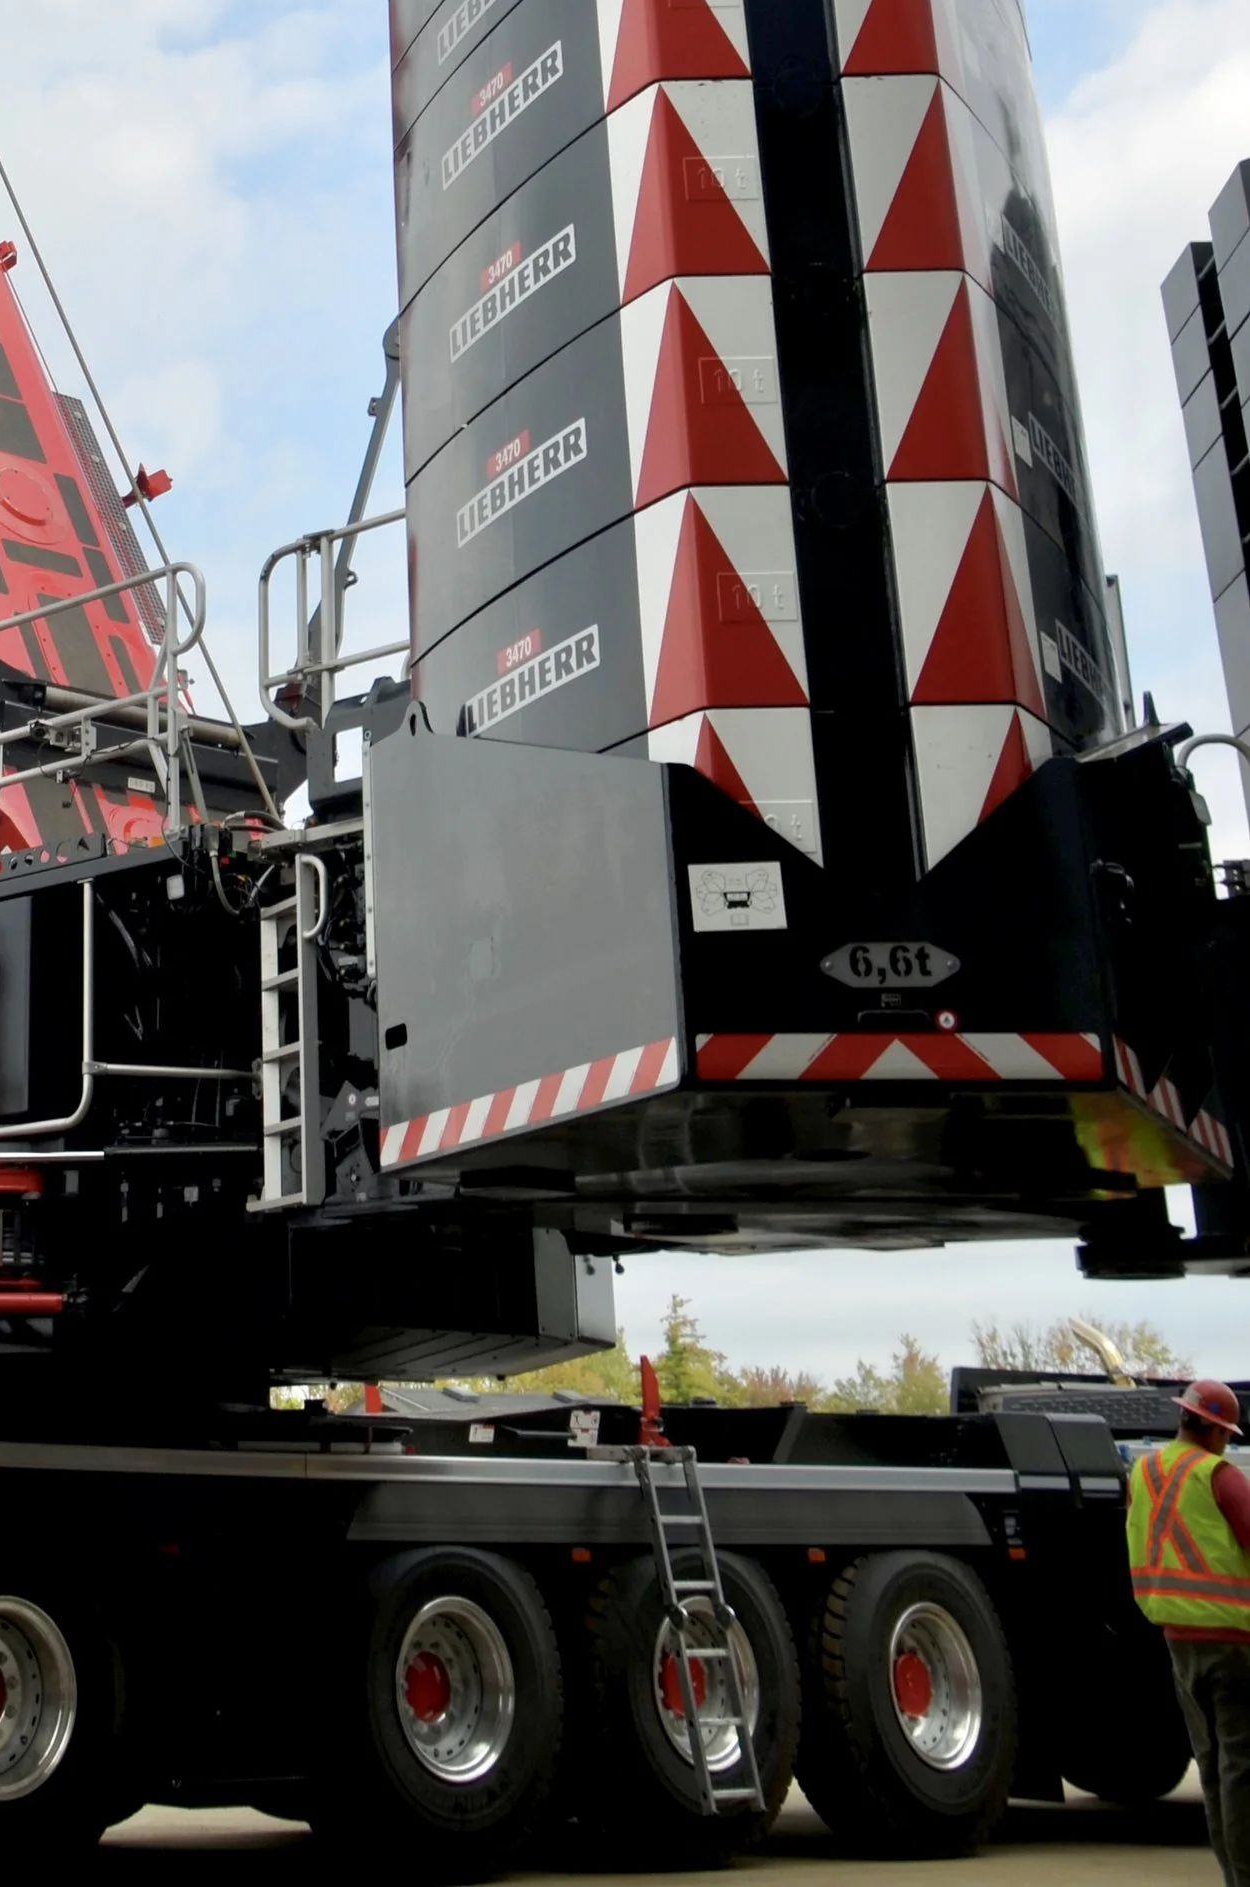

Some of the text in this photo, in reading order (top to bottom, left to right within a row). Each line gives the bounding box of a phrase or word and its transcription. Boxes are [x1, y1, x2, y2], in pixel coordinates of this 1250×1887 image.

[479, 73, 504, 108] 3470
[443, 43, 562, 188] LIEBHERR
[488, 250, 513, 285] 3470
[451, 226, 575, 361] LIEBHERR
[495, 438, 521, 472] 3470
[457, 420, 586, 547] LIEBHERR
[506, 636, 532, 668] 3470
[466, 627, 599, 737] LIEBHERR
[848, 944, 933, 985] 6,6t
